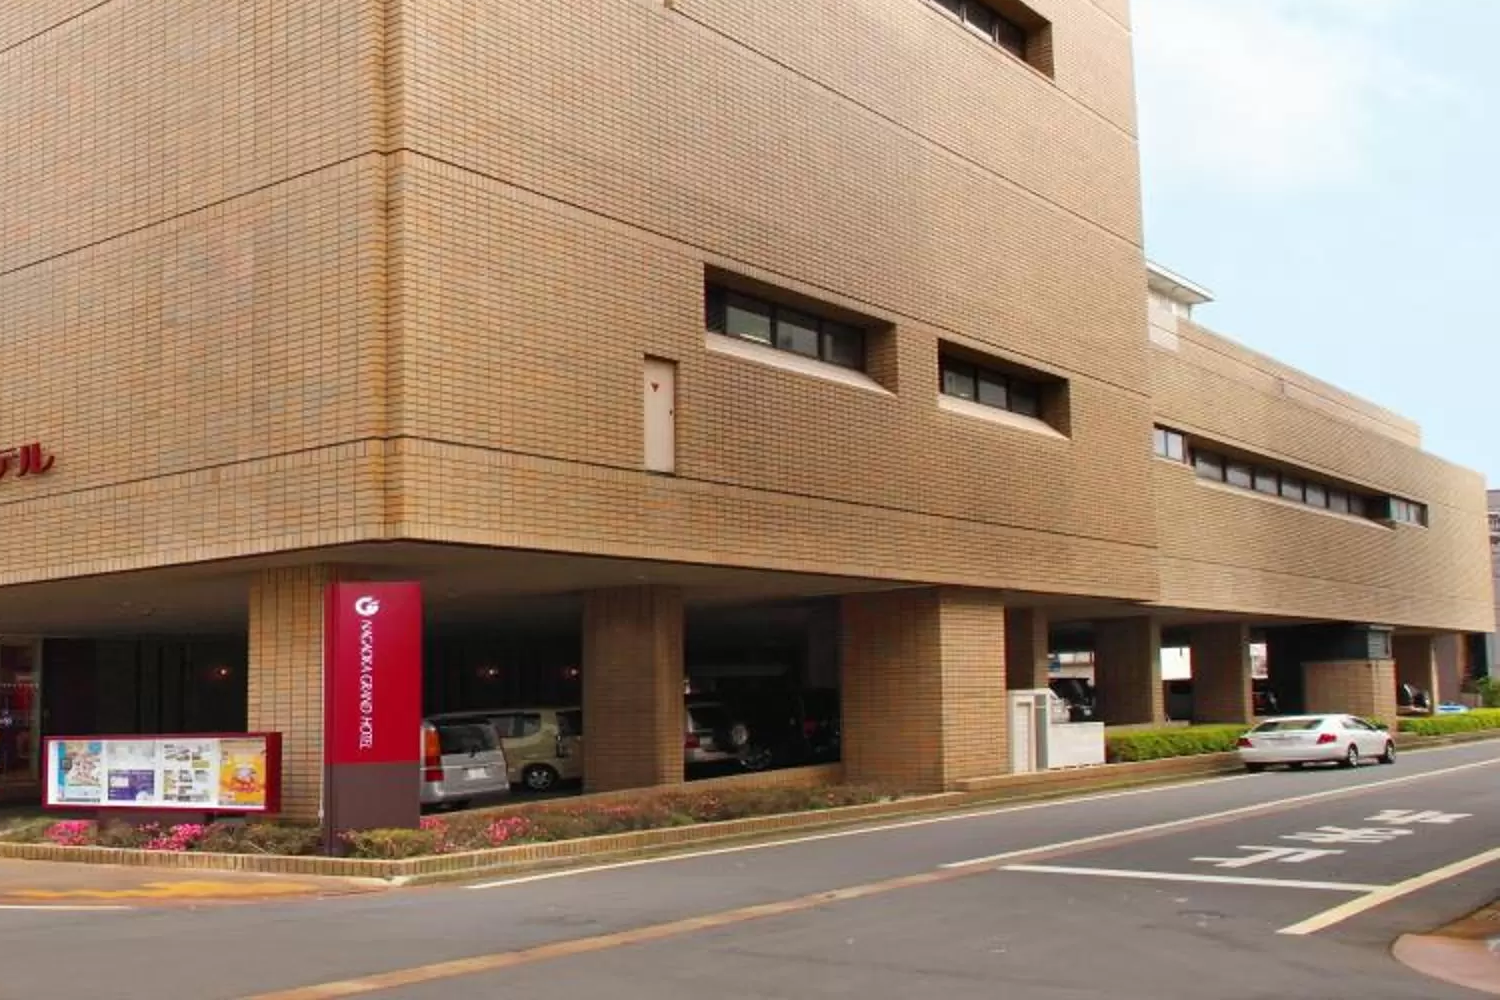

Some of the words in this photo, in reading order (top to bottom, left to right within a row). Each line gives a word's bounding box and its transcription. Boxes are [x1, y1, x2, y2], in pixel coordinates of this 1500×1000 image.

[360, 619, 373, 673] NAGAOKA
[359, 674, 373, 714] GRAND
[359, 716, 373, 750] HOTEL
